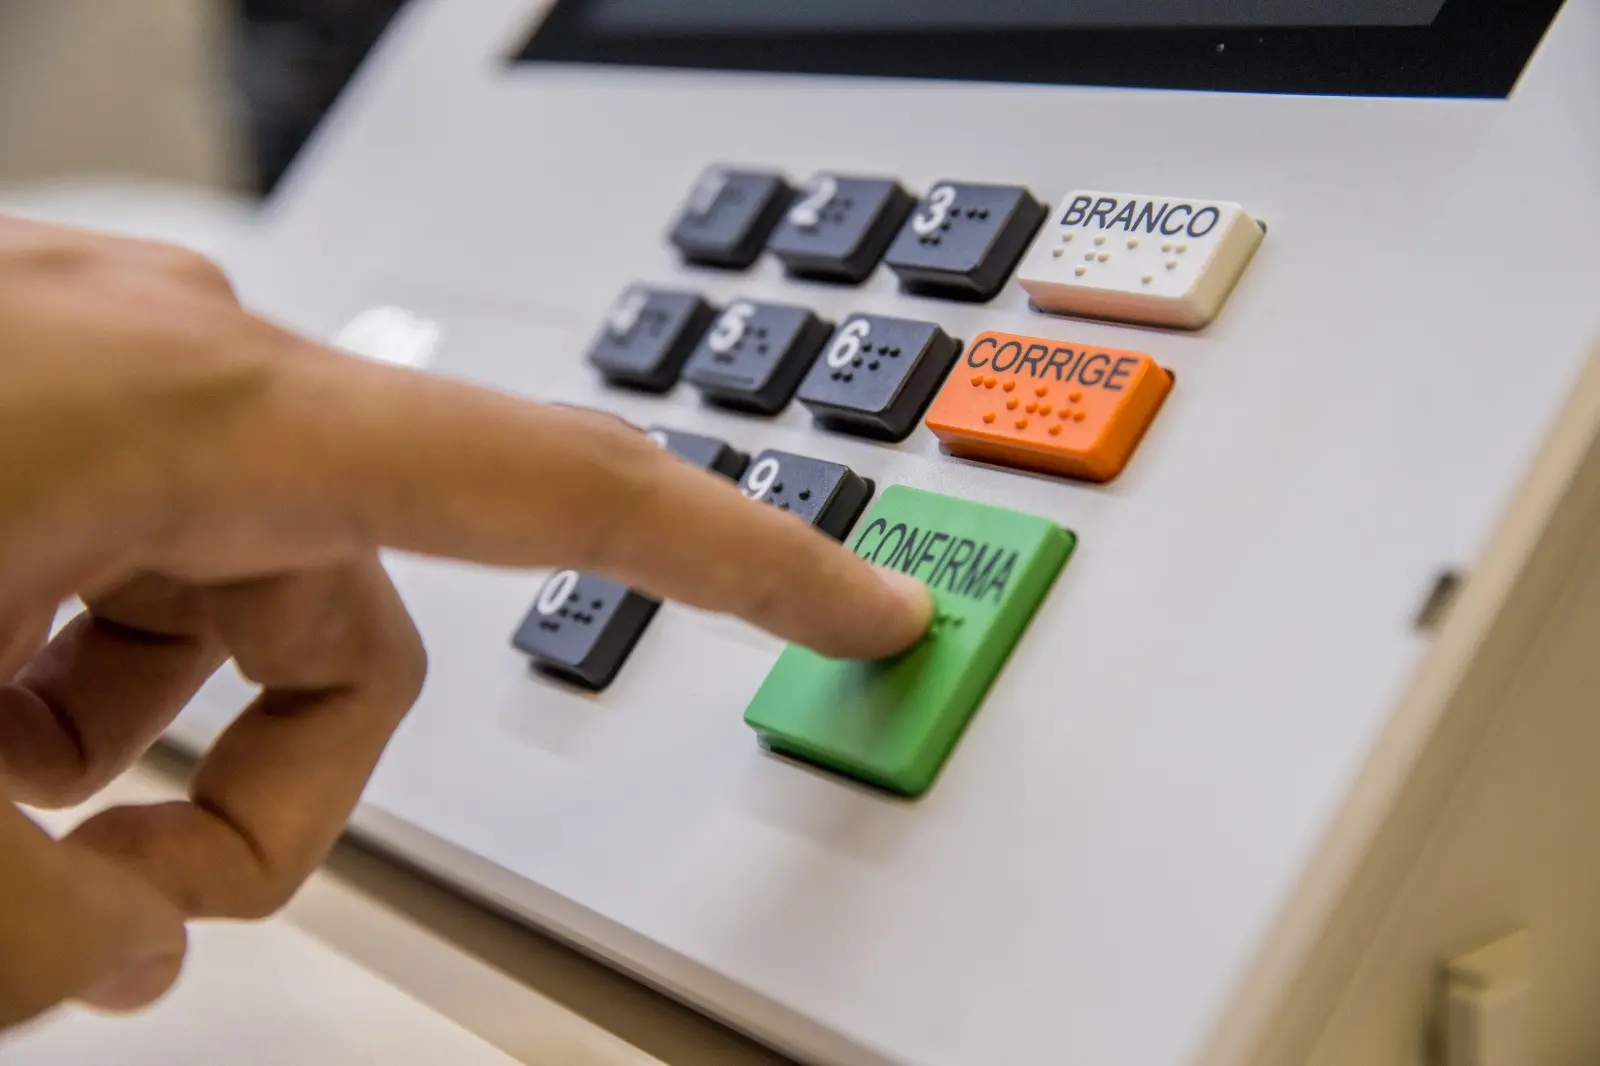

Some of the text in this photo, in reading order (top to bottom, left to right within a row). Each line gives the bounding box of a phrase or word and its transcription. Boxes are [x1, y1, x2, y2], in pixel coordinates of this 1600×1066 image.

[789, 176, 836, 227] 2
[912, 186, 956, 235] 3
[1060, 195, 1220, 237] BRANCO
[708, 303, 755, 352] 5
[826, 319, 870, 368] 6
[967, 338, 1139, 391] CORRIGE
[740, 457, 779, 501] 9
[853, 517, 1019, 604] CONFIRMA
[537, 569, 579, 615] 0
